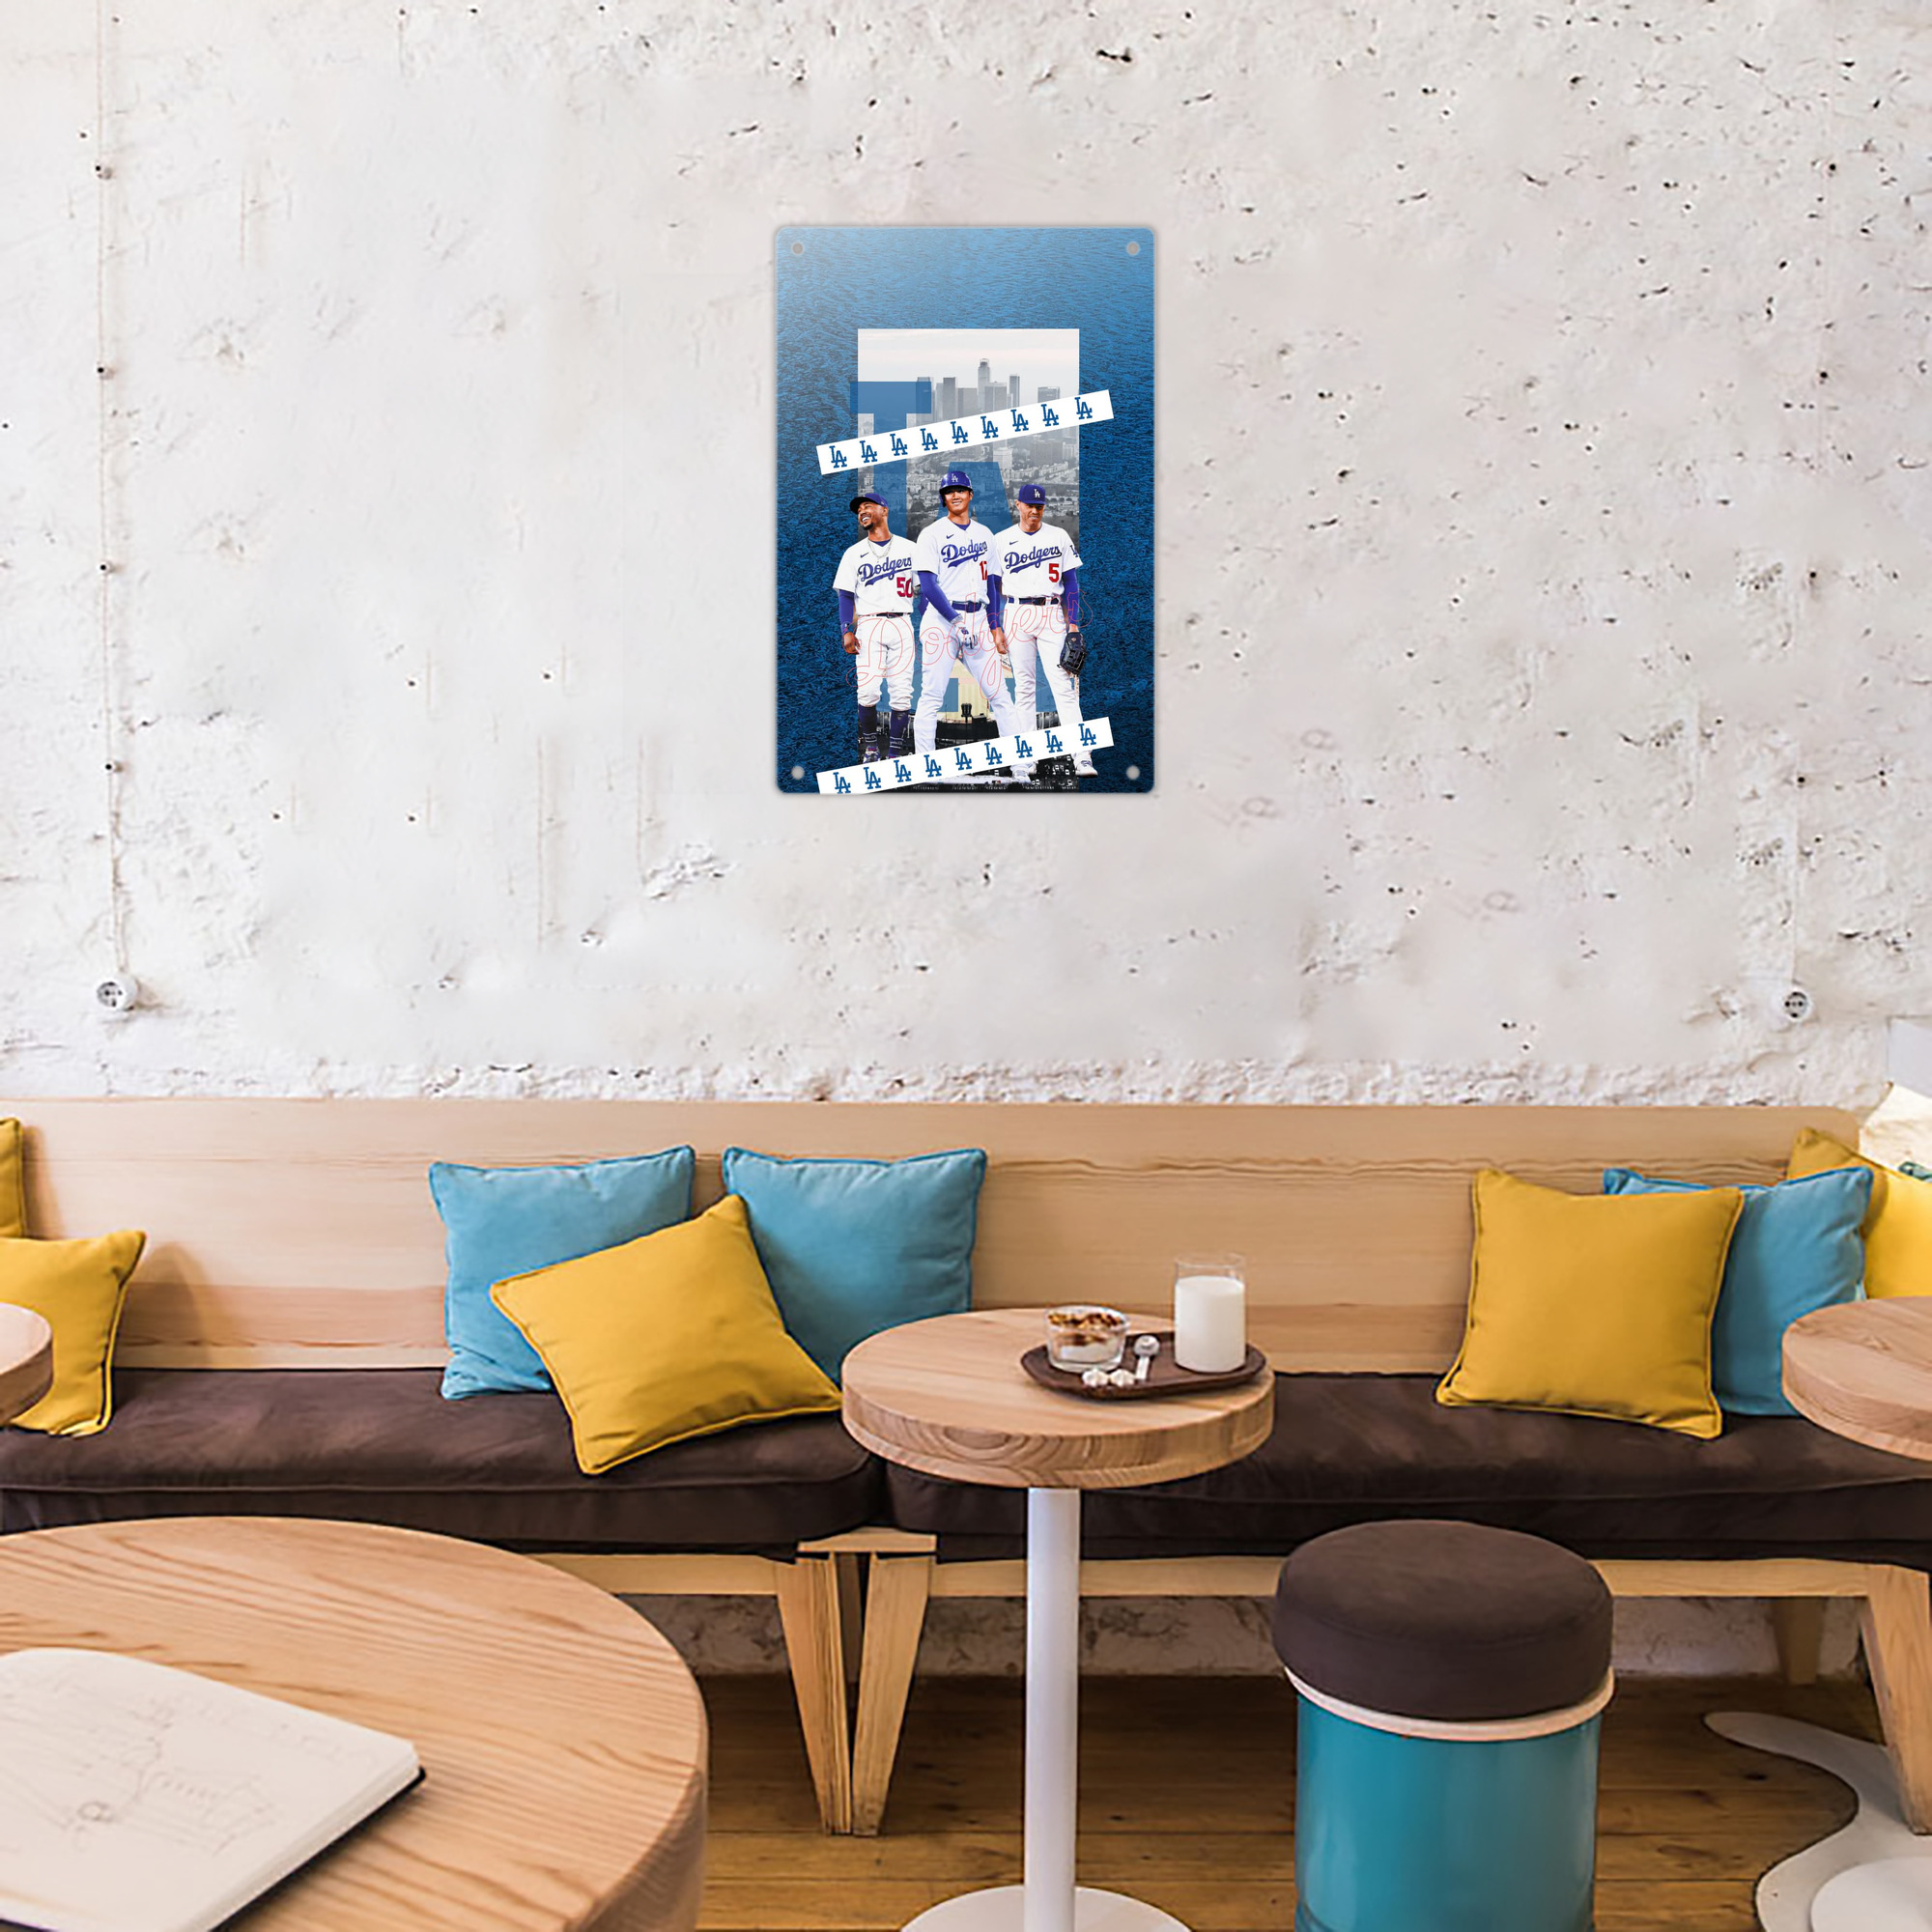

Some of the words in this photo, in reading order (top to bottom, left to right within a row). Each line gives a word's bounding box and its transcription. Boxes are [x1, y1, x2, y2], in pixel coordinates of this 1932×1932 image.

[830, 445, 847, 469] LA
[860, 440, 877, 463] LA
[890, 434, 908, 456] LA
[921, 428, 938, 451] LA
[951, 421, 968, 444] LA
[980, 416, 999, 439] LA
[1010, 409, 1029, 432] LA
[1041, 404, 1059, 426] LA
[1074, 396, 1093, 419] LA
[951, 473, 959, 483] LA
[1004, 546, 1062, 574] Dodgers
[1048, 563, 1060, 582] 5
[896, 577, 913, 598] 50
[846, 589, 1093, 699] Dodgers
[834, 772, 851, 794] LA
[863, 767, 881, 789] LA
[894, 760, 911, 782] LA
[923, 754, 942, 777] LA
[954, 748, 972, 770] LA
[984, 743, 1002, 765] LA
[1014, 736, 1033, 758] LA
[1045, 730, 1063, 753] LA
[1078, 724, 1096, 746] LA
